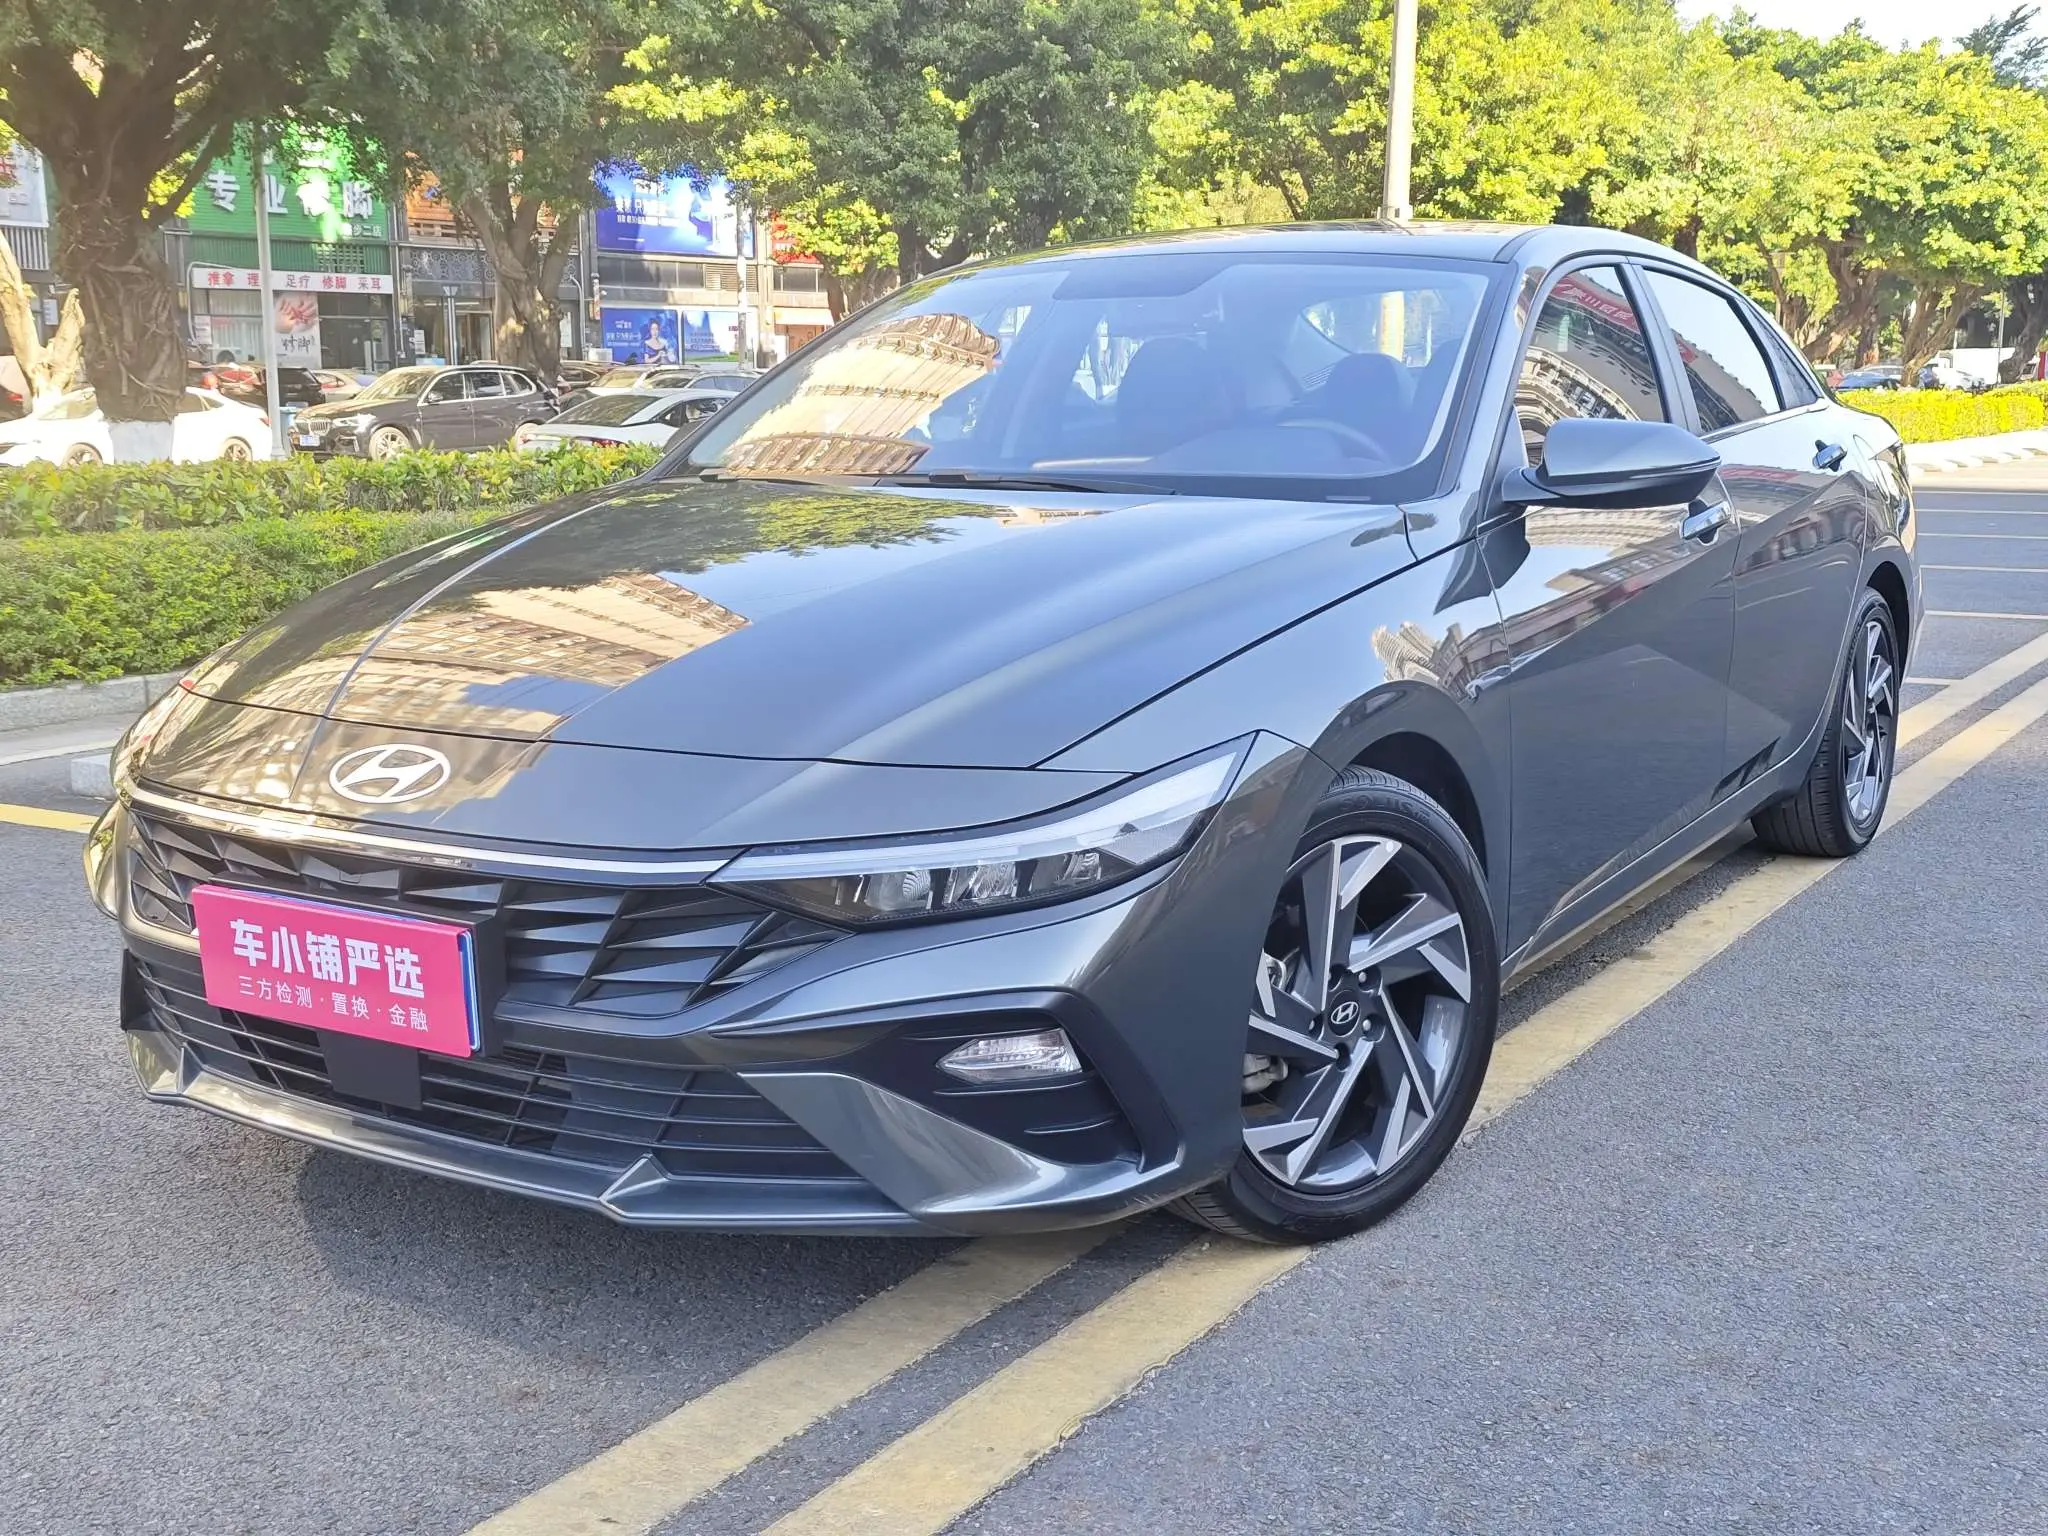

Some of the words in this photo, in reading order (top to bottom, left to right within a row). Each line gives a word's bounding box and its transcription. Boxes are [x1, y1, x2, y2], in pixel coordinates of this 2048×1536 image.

[207, 270, 235, 288] 推拿
[285, 273, 311, 289] 足疗
[322, 275, 347, 290] 修脚
[357, 277, 382, 291] 采耳
[229, 917, 426, 999] 车小铺严选
